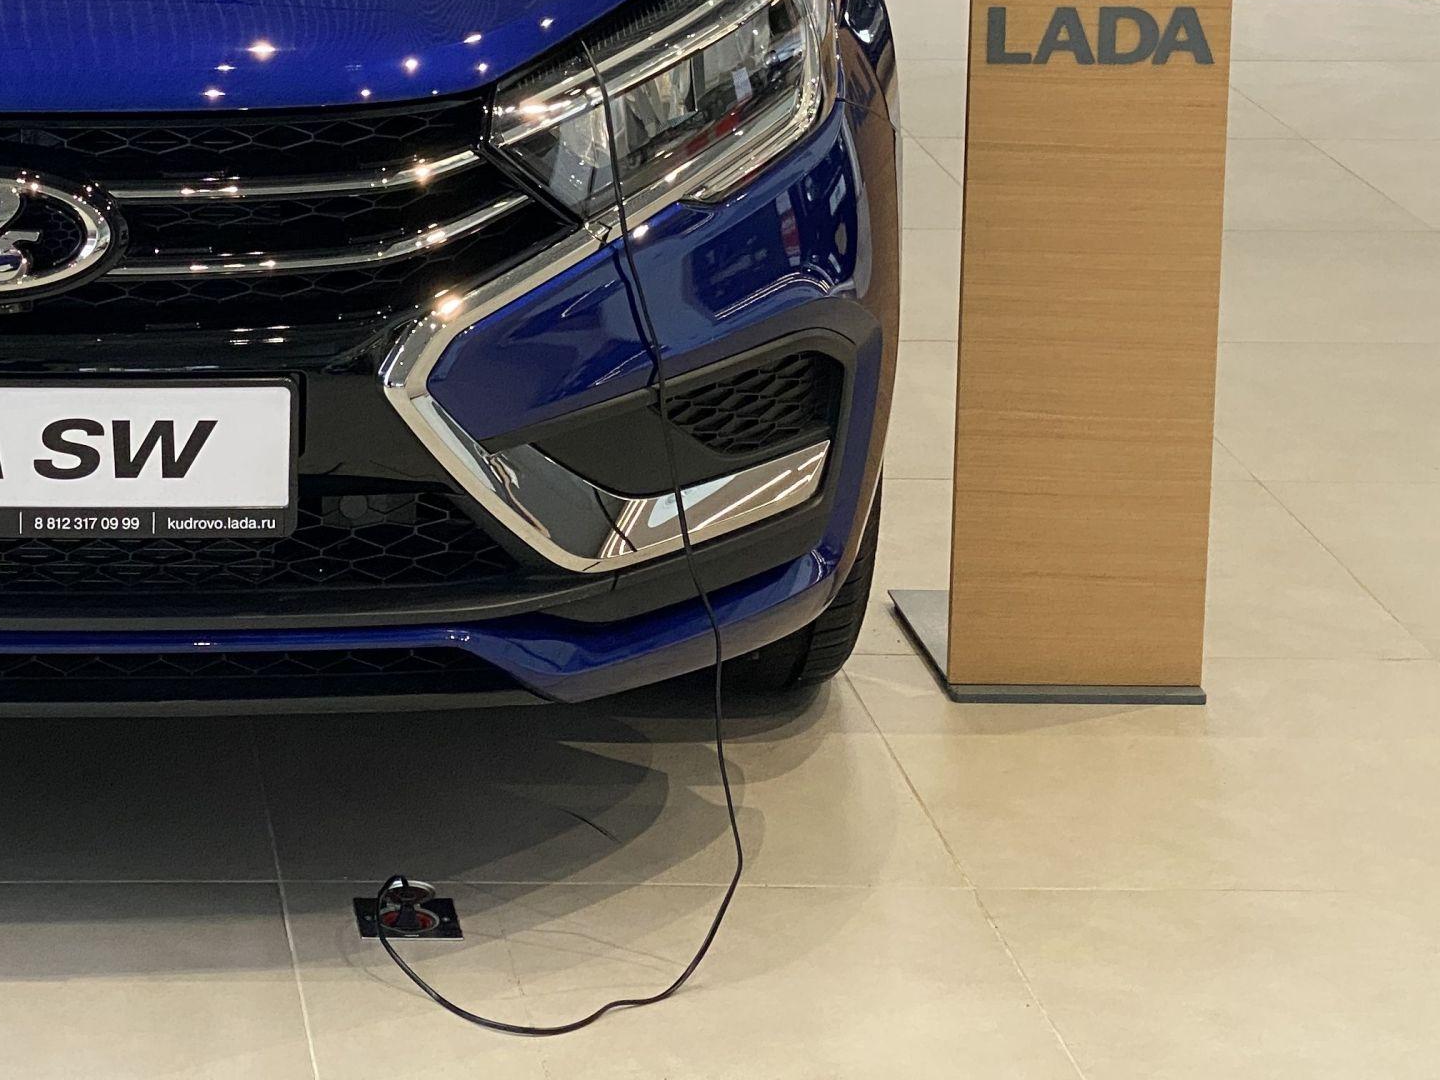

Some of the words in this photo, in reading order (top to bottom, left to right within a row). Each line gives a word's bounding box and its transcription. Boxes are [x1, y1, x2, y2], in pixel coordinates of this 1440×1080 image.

[986, 6, 1216, 65] LADA
[33, 417, 219, 480] SW
[34, 517, 44, 530] 8
[46, 517, 72, 530] 812
[73, 517, 99, 530] 317
[100, 517, 119, 530] 09
[121, 517, 141, 530] 99
[167, 517, 276, 530] kudrovo.lada.ru
